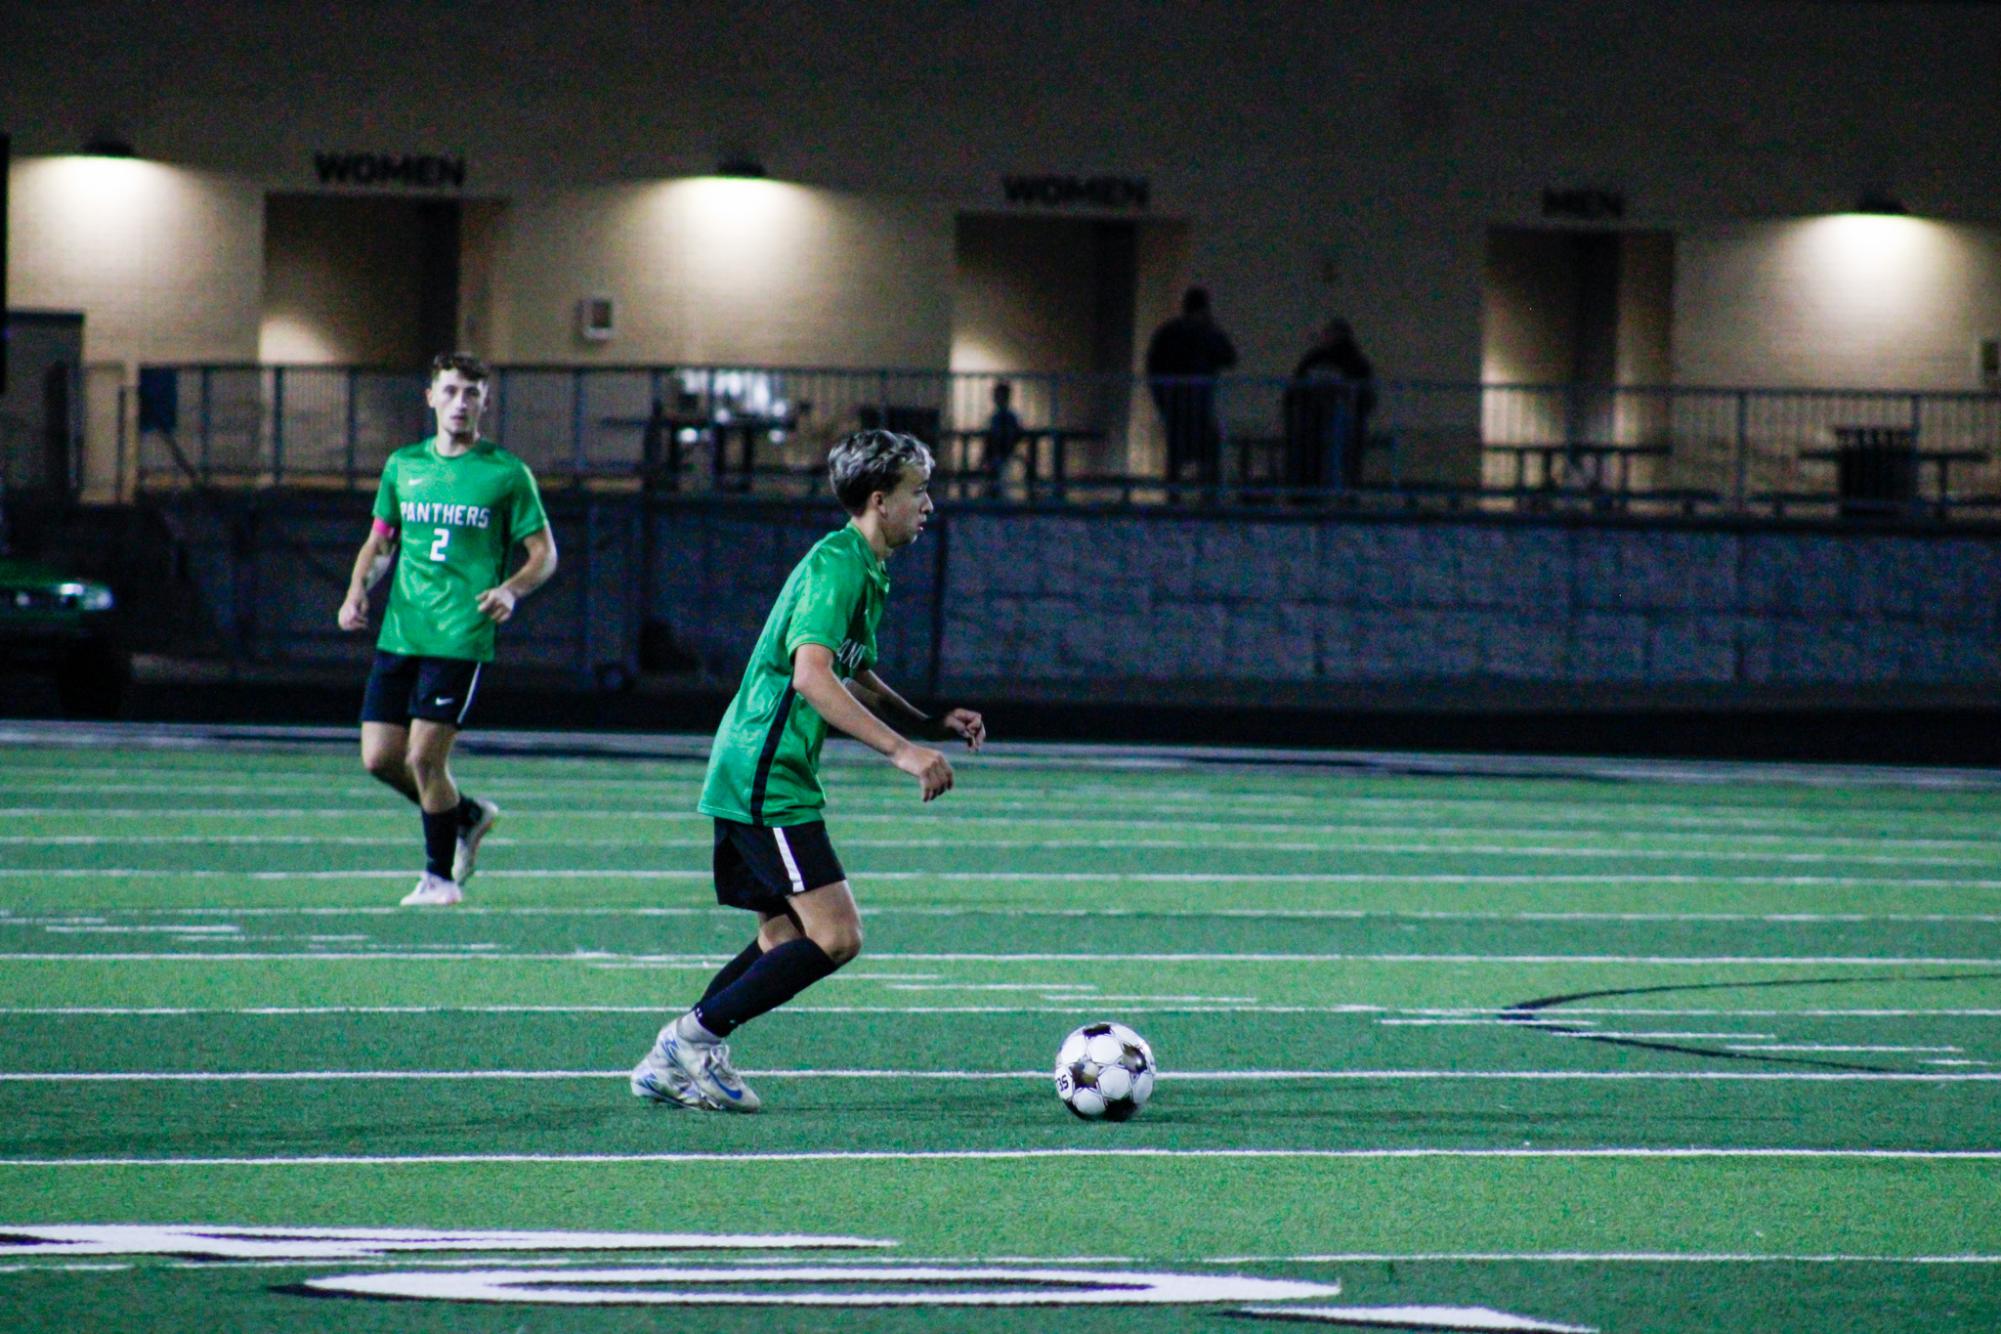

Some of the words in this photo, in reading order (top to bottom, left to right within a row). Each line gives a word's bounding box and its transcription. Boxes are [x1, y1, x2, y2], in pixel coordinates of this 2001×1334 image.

[315, 152, 465, 187] WOMEN
[1003, 174, 1148, 206] WOMEN
[1543, 189, 1622, 217] MEN
[400, 501, 490, 529] PANTHERS
[429, 528, 450, 562] 2
